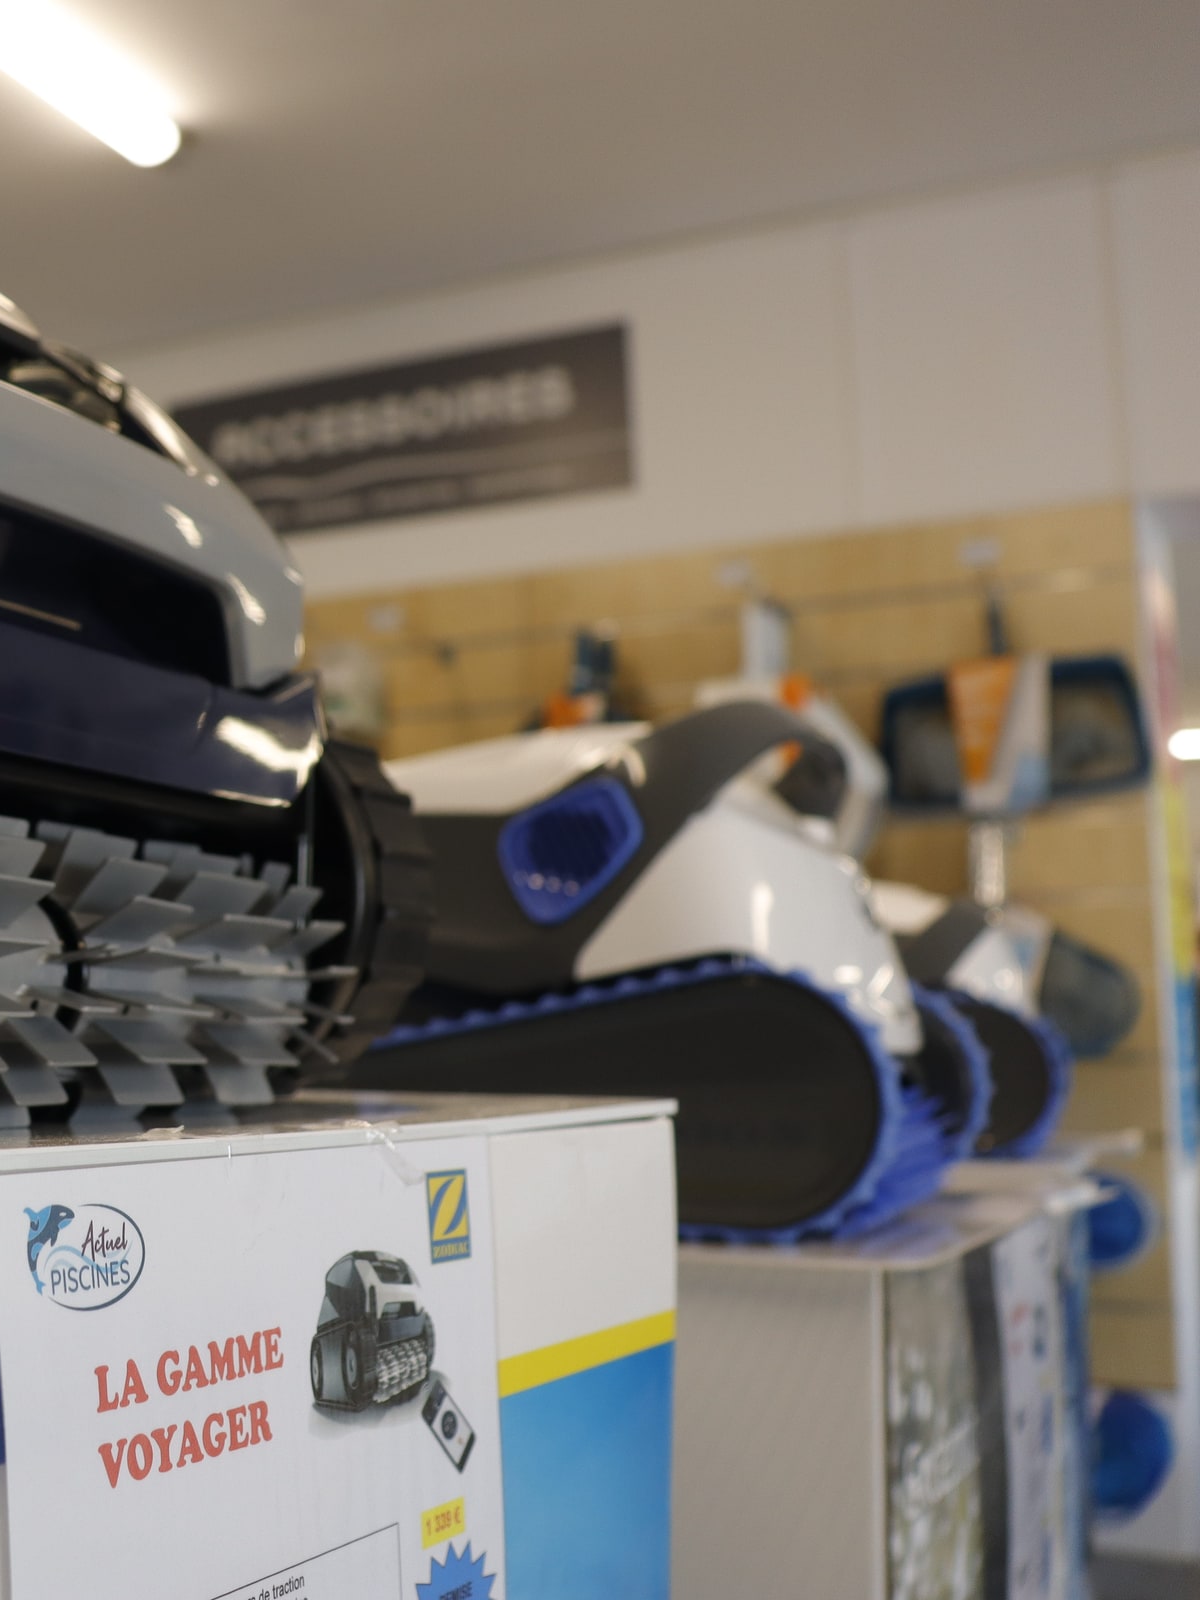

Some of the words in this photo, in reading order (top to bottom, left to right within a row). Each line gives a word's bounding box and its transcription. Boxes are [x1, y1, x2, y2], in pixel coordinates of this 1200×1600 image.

[212, 365, 574, 466] ACCESSOIRES
[81, 1219, 127, 1262] Actuel
[51, 1259, 131, 1296] PISCINES
[94, 1358, 149, 1413] LA
[156, 1326, 284, 1396] GAMME
[98, 1400, 272, 1488] VOYAGER
[272, 1576, 306, 1600] traction
